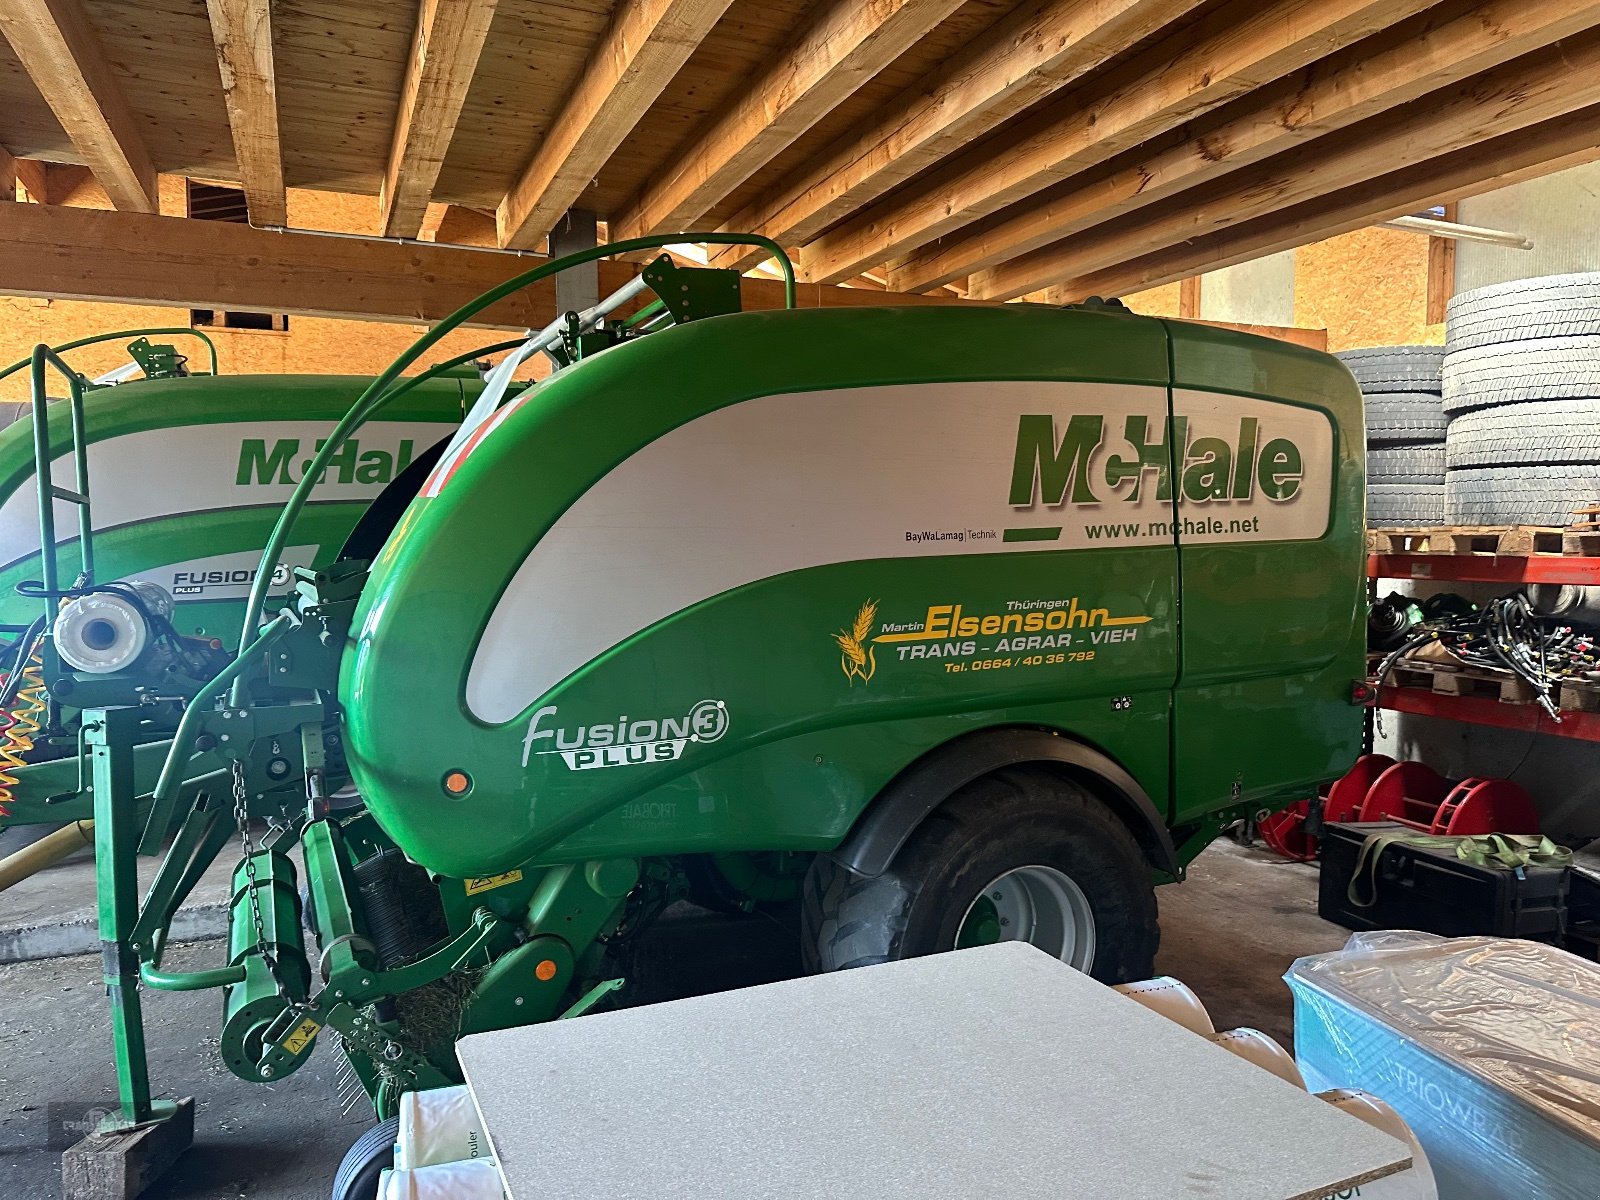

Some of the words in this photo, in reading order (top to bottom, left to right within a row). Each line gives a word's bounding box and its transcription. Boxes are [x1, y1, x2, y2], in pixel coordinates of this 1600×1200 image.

[1008, 414, 1303, 506] McHale
[1085, 515, 1260, 540] www.mchale.net
[881, 621, 925, 633] Martin
[923, 598, 1112, 638] Elsensohn
[1006, 599, 1070, 612] Thüringen
[896, 641, 976, 661] TRANS
[994, 634, 1072, 653] AGRAR
[1090, 628, 1138, 645] VIEH
[944, 663, 968, 673] Tel.
[971, 659, 1012, 671] 0664
[1022, 655, 1044, 666] 40
[1046, 653, 1066, 665] 36
[1068, 651, 1095, 662] 792
[574, 743, 675, 769] PLUS
[467, 1131, 478, 1159] ouler
